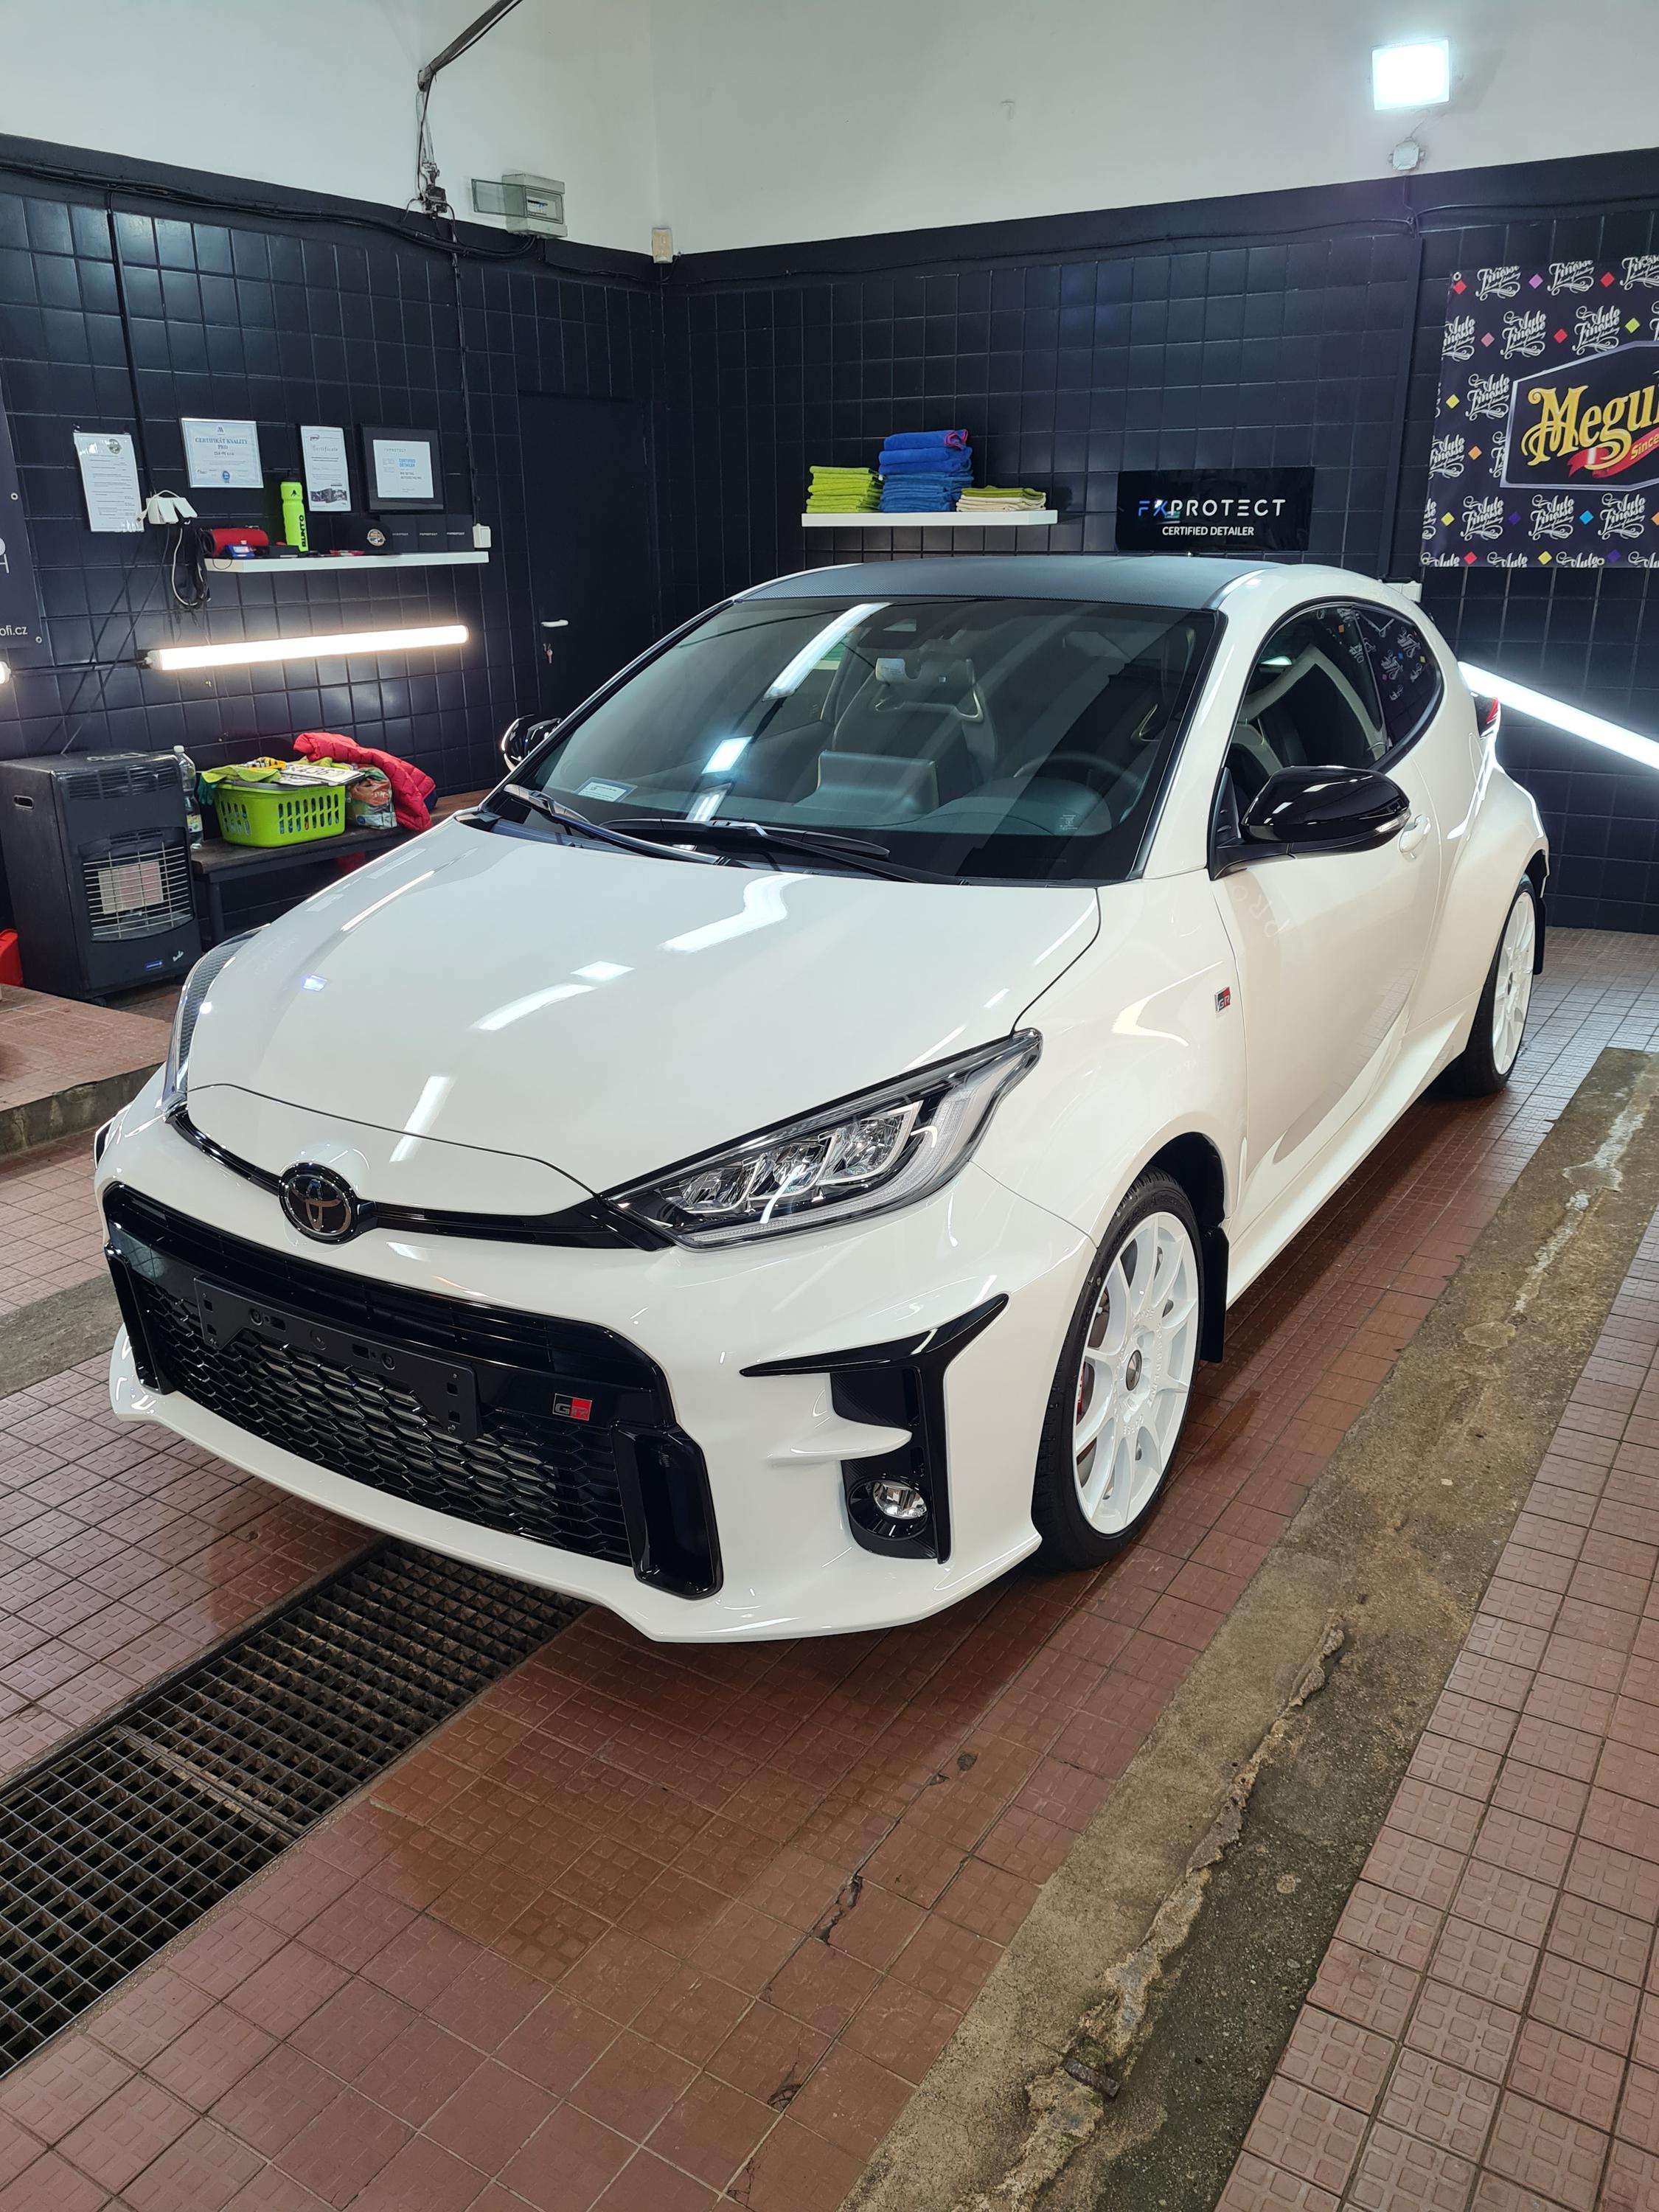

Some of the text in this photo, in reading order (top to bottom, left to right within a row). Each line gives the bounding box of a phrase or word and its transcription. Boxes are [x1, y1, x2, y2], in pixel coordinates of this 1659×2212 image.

[1503, 310, 1546, 330] Auto
[1576, 305, 1621, 324] Auto
[1500, 321, 1545, 355] Finesse
[1572, 316, 1620, 351] Finesse
[1468, 374, 1510, 392] Auto
[1465, 385, 1509, 417] Finesse
[1464, 495, 1504, 514] Auto
[1531, 494, 1575, 513] Auto
[1601, 493, 1646, 512] Auto
[1460, 507, 1503, 537] Finesse
[1528, 506, 1573, 536] Finesse
[1598, 505, 1645, 535] Finesse
[1162, 526, 1255, 536] CERTIFIED DETAILER
